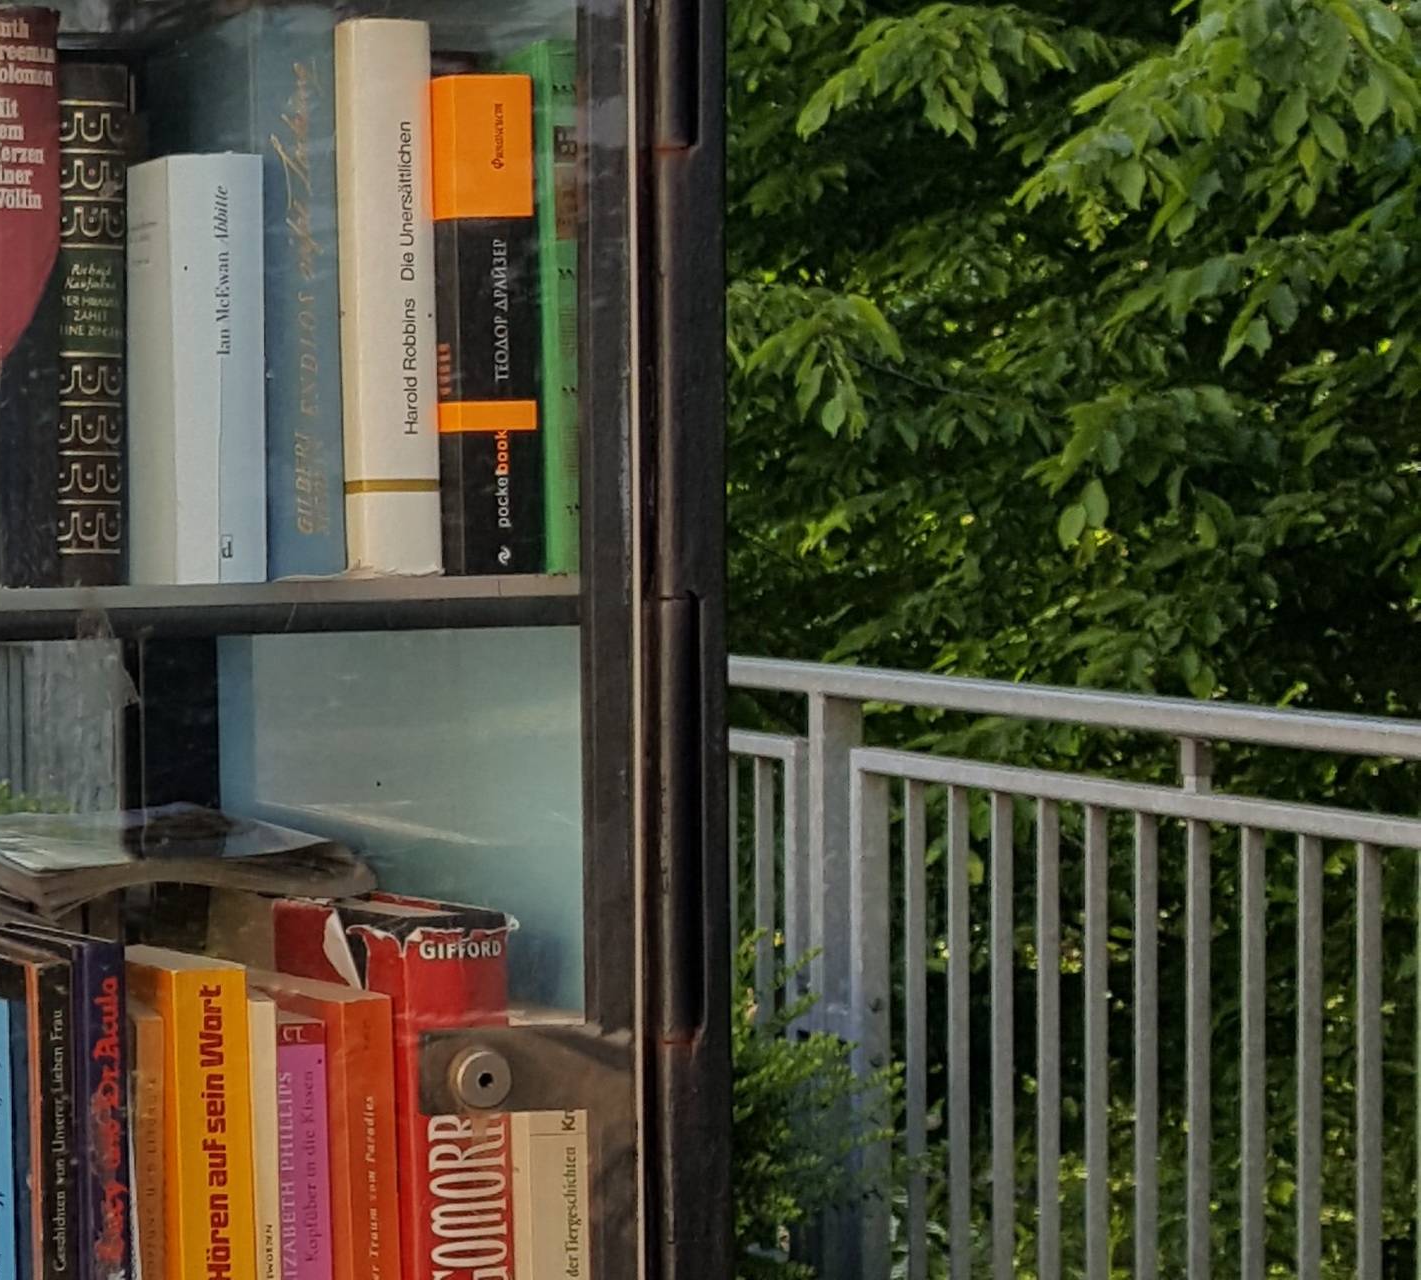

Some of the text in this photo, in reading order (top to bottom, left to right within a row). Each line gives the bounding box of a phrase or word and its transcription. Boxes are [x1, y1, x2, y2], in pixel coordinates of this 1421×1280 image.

[213, 184, 231, 355] Ian McEwan Abbitte
[398, 120, 418, 435] Harold Robbins Die Unersättlichen
[493, 238, 509, 382] ТЕОДОР ДРАЙЗЕР
[496, 428, 509, 528] pocketbook
[419, 940, 502, 959] GIFFORD
[50, 1009, 64, 1042] Frau
[199, 985, 225, 1068] Wort
[50, 1048, 65, 1092] Lieben
[300, 1071, 316, 1125] Kissen
[50, 1097, 66, 1153] Unserer
[201, 1074, 227, 1133] sein
[278, 1072, 295, 1172] PHILLIPS
[364, 1095, 377, 1163] Paradies
[202, 1141, 228, 1188] auf
[302, 1131, 317, 1156] die
[367, 1207, 380, 1258] Traum
[562, 1146, 581, 1277] der Tiergeschichten
